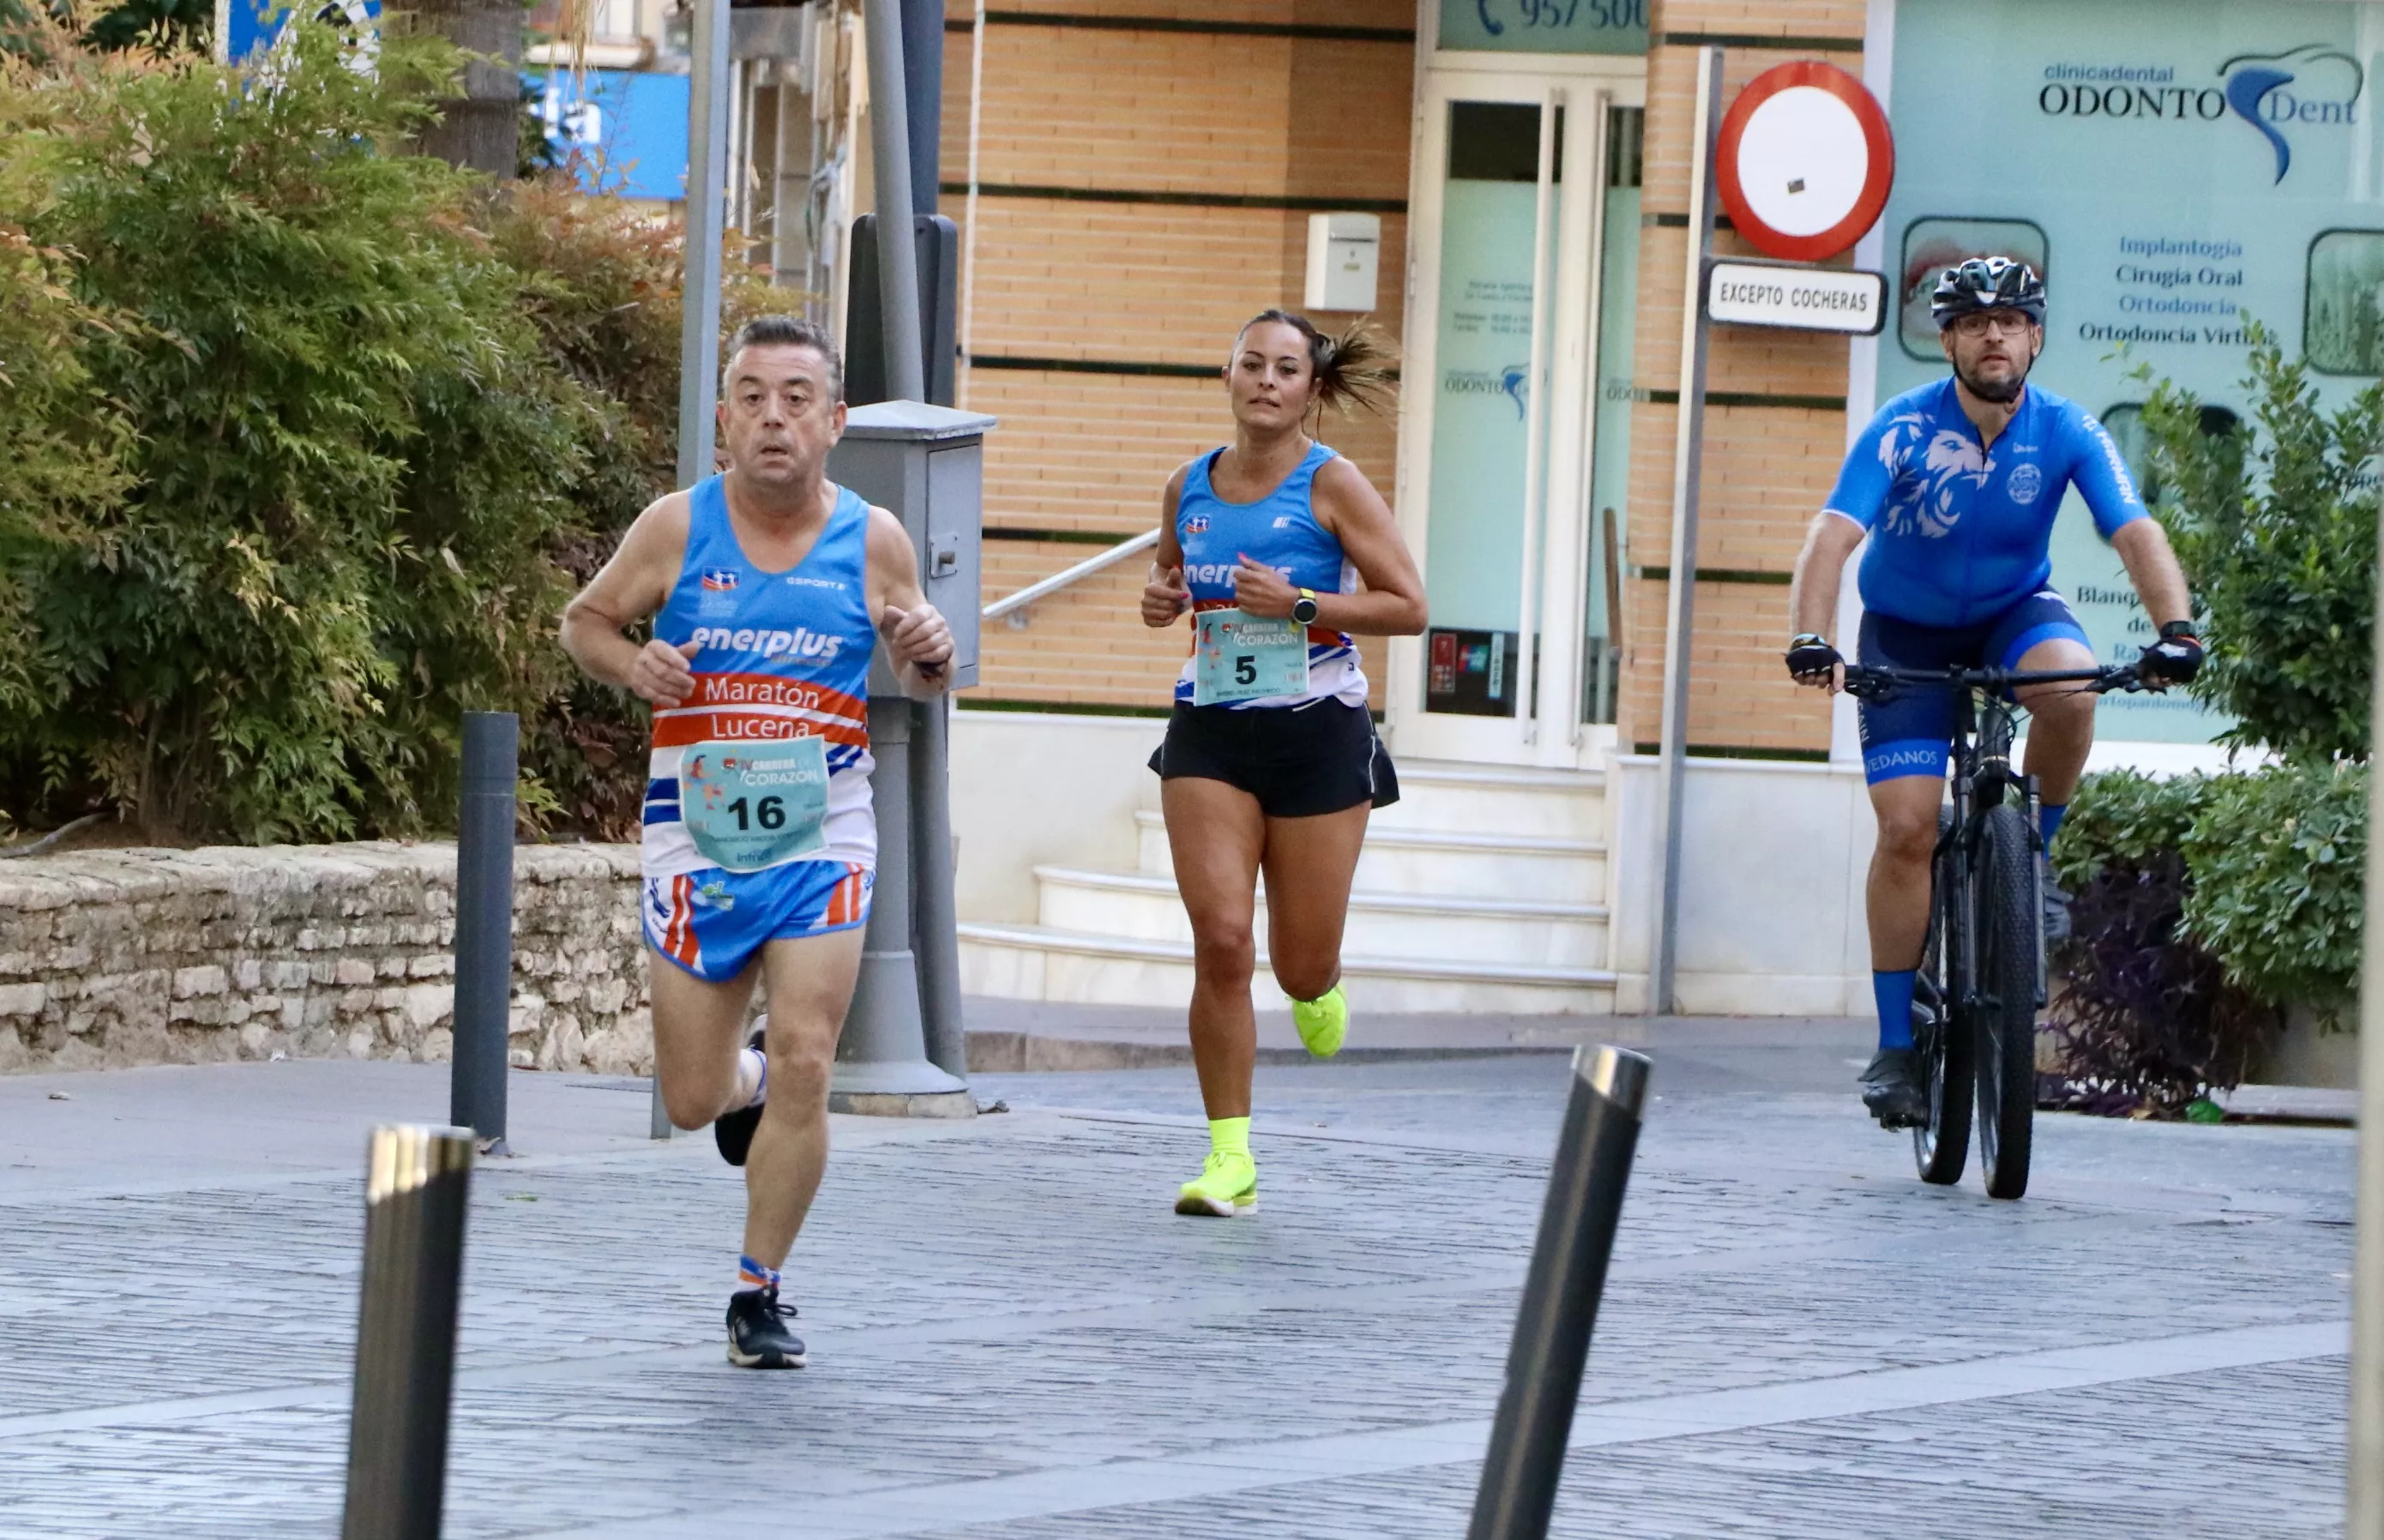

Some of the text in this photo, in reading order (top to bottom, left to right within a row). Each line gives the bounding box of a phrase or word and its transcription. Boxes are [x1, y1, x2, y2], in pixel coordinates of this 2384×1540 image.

[2039, 84, 2357, 124] ODONTO Dent
[2198, 266, 2243, 286] Oral
[1720, 282, 1868, 312] EXCEPTO COCHERAS
[2119, 295, 2237, 315] Ortodoncia
[2079, 322, 2196, 343] Ortodoncia
[692, 627, 844, 658] enerplus
[1235, 655, 1257, 685] 5
[705, 677, 820, 709] Maratón
[712, 713, 810, 738] Lucena
[727, 796, 786, 831] 16
